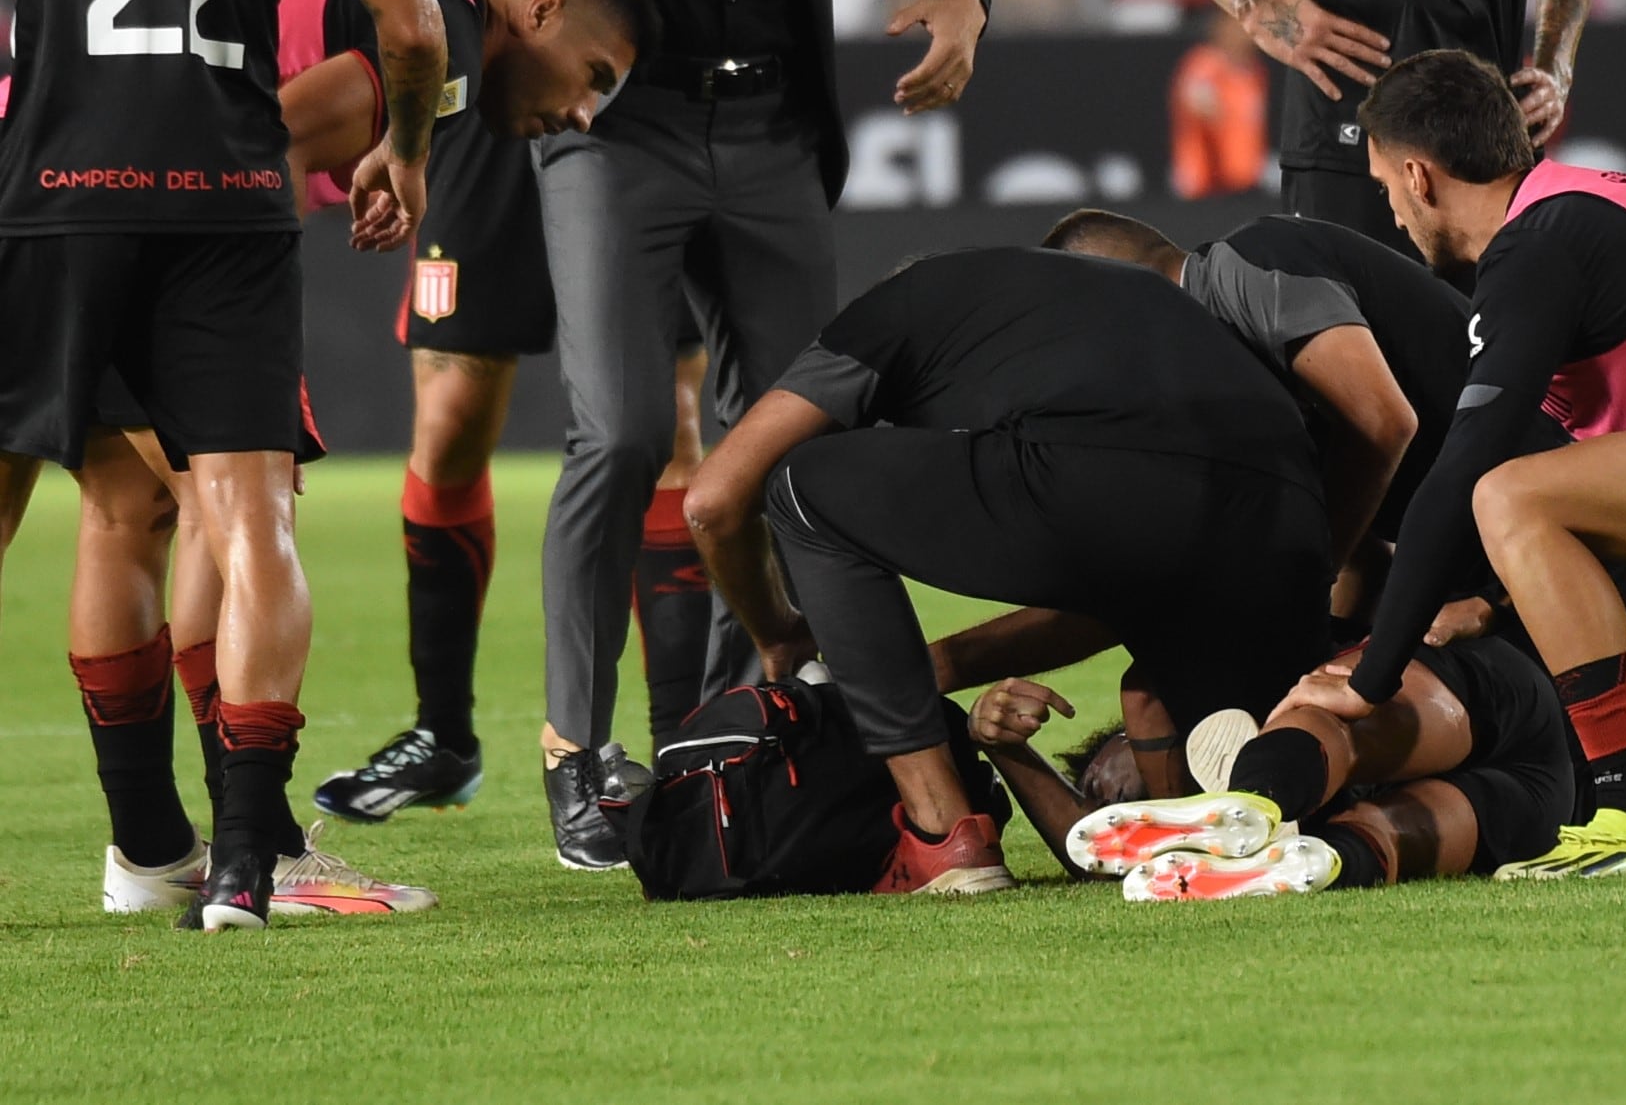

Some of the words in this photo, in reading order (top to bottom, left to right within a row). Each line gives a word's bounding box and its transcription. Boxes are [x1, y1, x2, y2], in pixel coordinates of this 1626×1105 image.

[39, 166, 156, 190] CAMPEÓN
[166, 170, 212, 190] DEL
[221, 170, 283, 190] MUNDO
